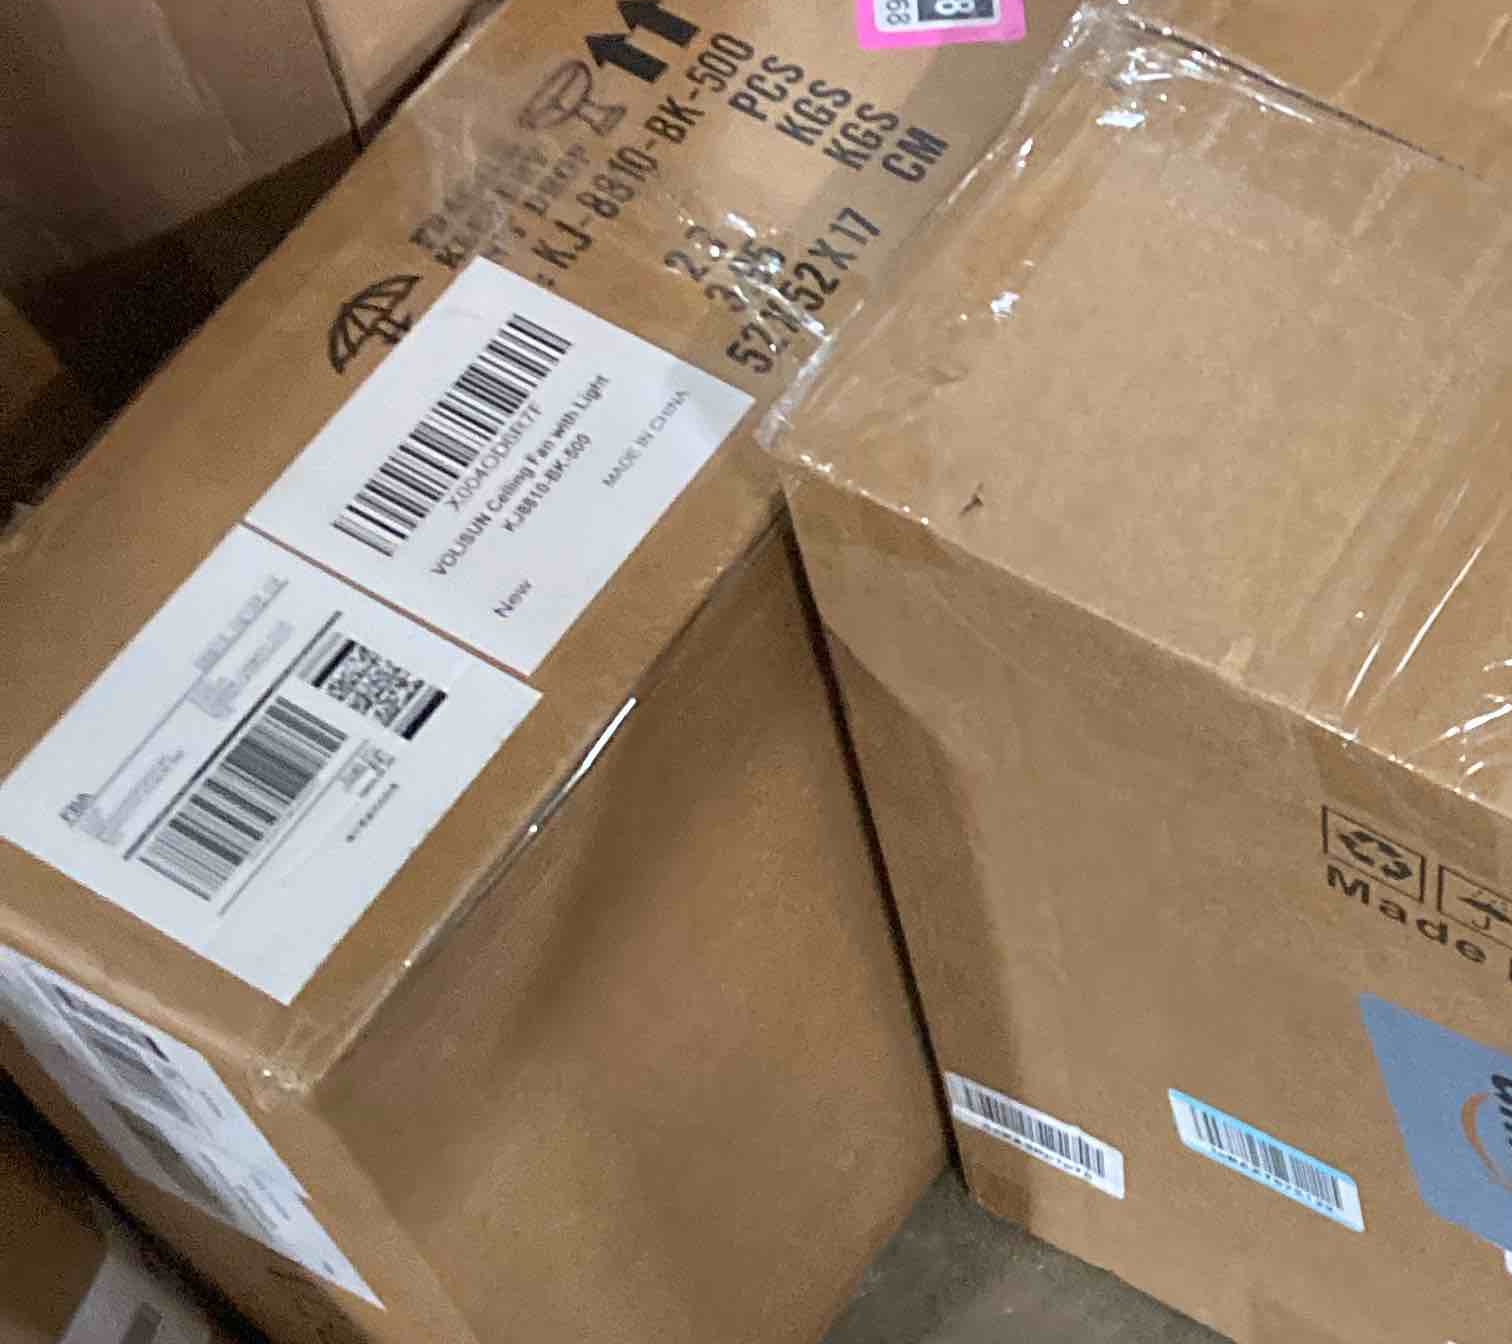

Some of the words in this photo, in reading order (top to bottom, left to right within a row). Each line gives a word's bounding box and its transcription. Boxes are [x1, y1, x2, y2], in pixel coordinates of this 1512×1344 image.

[728, 55, 804, 123] PCS
[776, 80, 852, 147] KGS
[531, 32, 755, 270] KJ-8810-BK-500
[823, 104, 899, 172] KGS
[881, 126, 949, 182] CM
[602, 445, 642, 489] MADE
[650, 389, 691, 433] CHINA
[430, 513, 492, 576] VOLISUN
[487, 464, 537, 514] Ceiling
[525, 438, 554, 471] Fan
[551, 408, 579, 439] with
[572, 374, 611, 412] Light
[493, 579, 533, 618] New
[1327, 863, 1487, 963] Made
